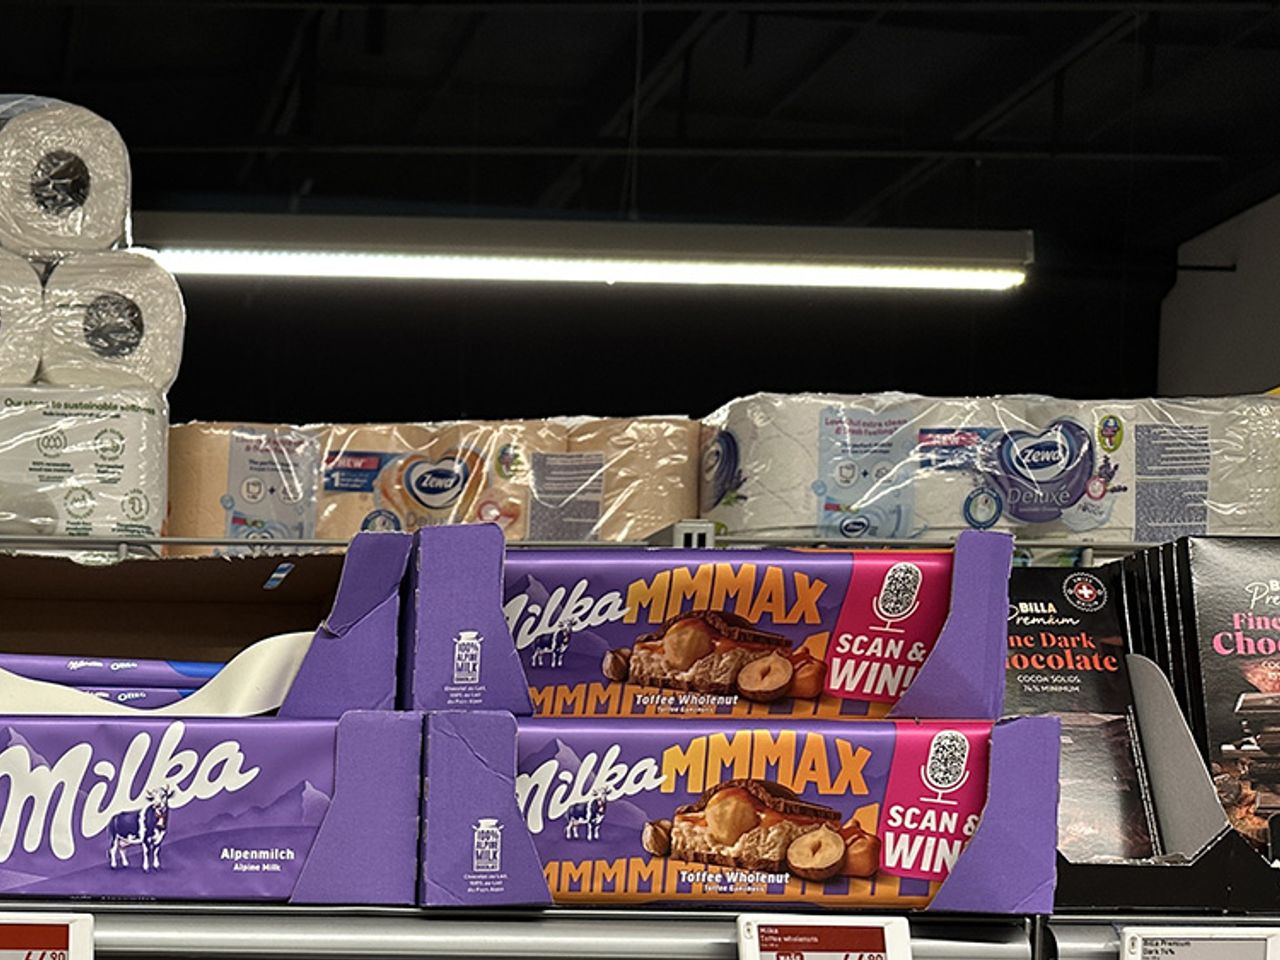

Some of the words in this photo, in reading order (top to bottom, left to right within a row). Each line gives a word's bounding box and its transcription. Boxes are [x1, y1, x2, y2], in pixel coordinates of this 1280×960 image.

[1023, 448, 1061, 463] Zewa
[421, 475, 455, 489] Zewa
[1007, 486, 1070, 505] Deluxe
[623, 563, 827, 624] MMMAX
[1019, 603, 1057, 613] BILLA
[836, 633, 905, 658] SCAN
[907, 641, 926, 661] &
[1040, 632, 1096, 649] Dark
[1005, 649, 1119, 672] ocolate
[455, 662, 480, 678] MILK
[518, 744, 667, 833] Milka
[660, 730, 871, 794] MMMAX
[887, 805, 958, 832] SCAN
[220, 847, 295, 862] Alpenmilch
[233, 863, 258, 873] Alpine
[261, 863, 281, 872] Milk
[681, 871, 720, 884] Toffee
[724, 871, 790, 884] Wholenut
